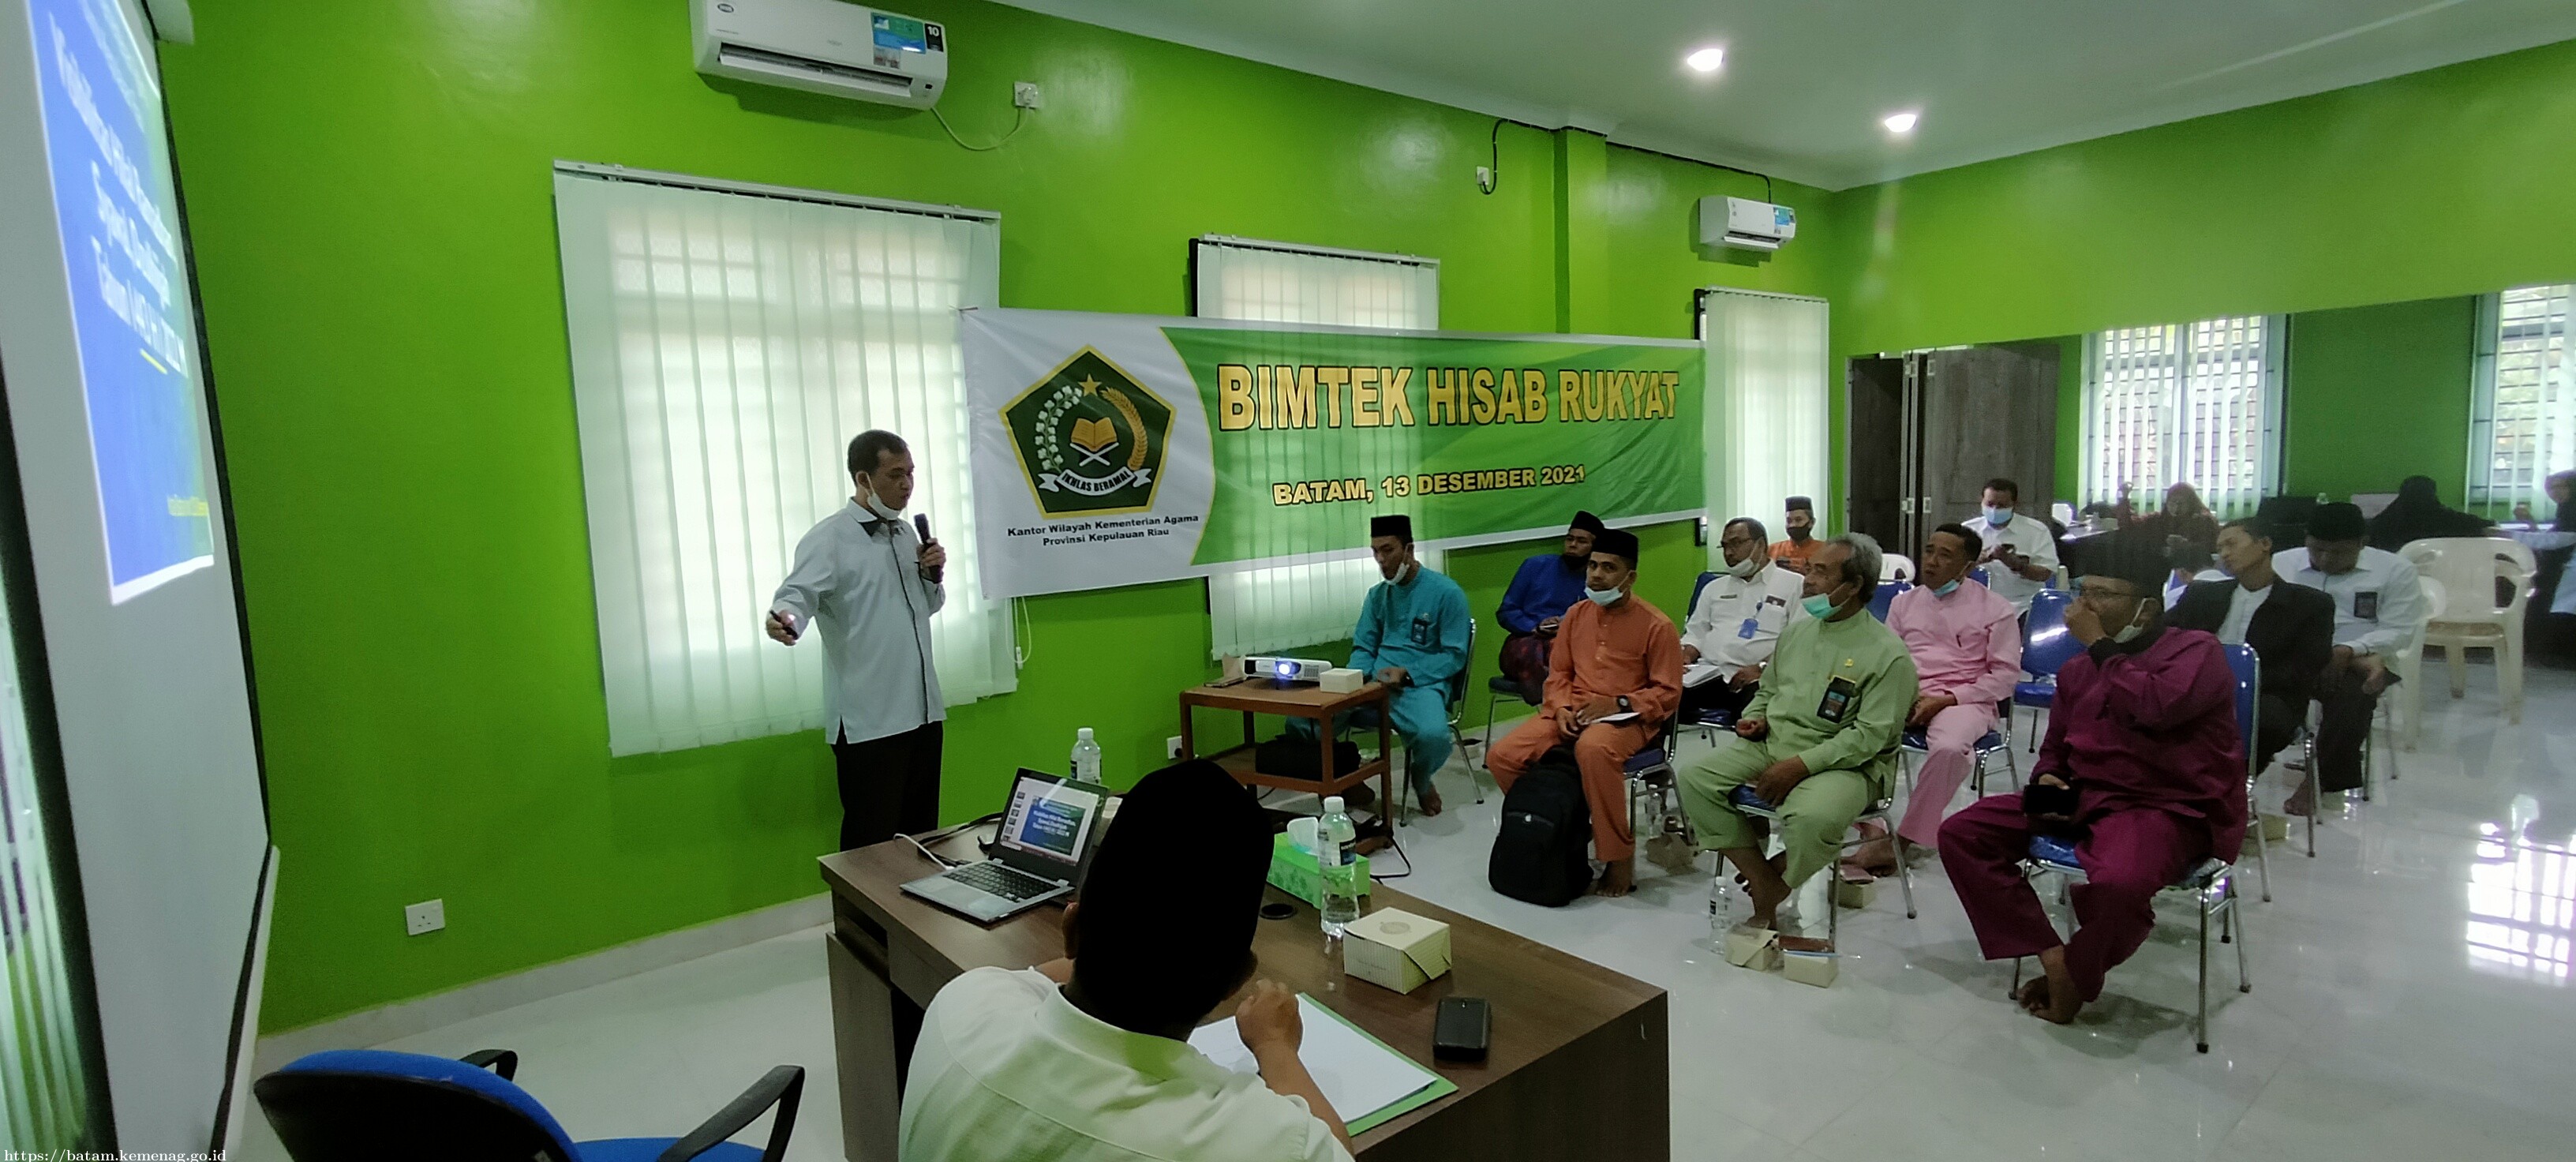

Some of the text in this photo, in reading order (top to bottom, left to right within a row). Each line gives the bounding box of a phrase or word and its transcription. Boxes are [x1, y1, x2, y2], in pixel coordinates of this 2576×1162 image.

[927, 26, 939, 36] 10
[1217, 364, 1680, 432] BIMTEK HISAB RUKYAT
[1061, 471, 1131, 492] IKHLAS BERAMAL
[1272, 464, 1586, 506] BATAM, 13 DESEMBER 2021
[1007, 515, 1199, 537] Kantor Wilayah Kementerian Agama
[1043, 528, 1170, 546] Provinsi Kepulauan Riau
